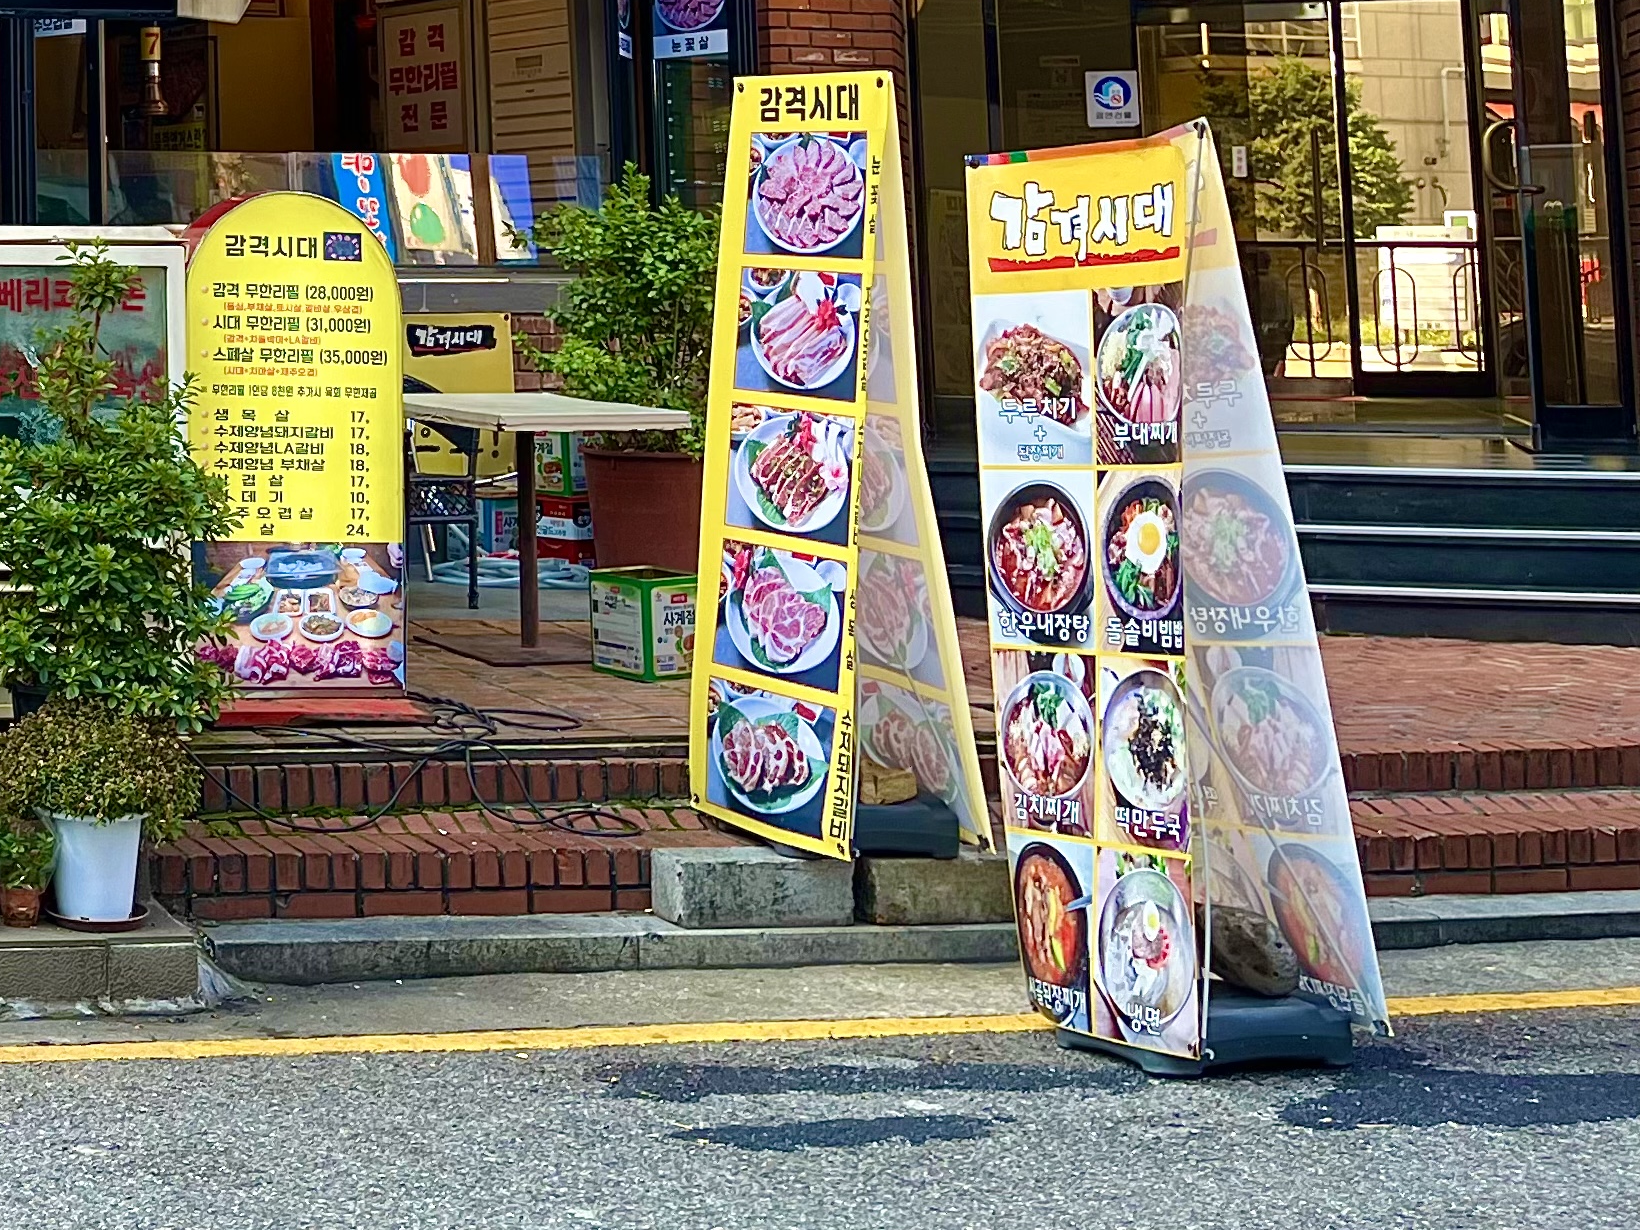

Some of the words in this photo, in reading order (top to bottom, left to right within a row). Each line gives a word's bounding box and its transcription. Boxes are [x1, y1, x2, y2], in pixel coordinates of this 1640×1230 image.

[145, 32, 160, 55] 7
[388, 60, 458, 96] 무한리필
[759, 82, 860, 123] 감격시대
[989, 180, 1175, 262] 감격시대
[224, 233, 318, 260] 감격시대
[212, 282, 240, 299] 감격
[245, 283, 300, 300] 무한리필
[305, 285, 374, 302] (28,000원)
[212, 315, 241, 331] 시대
[246, 316, 300, 332] 무한리필
[306, 317, 371, 334] (31,000원)
[259, 347, 314, 364] 무한리필
[319, 349, 388, 366] (35,000원)
[999, 396, 1078, 424] 두루치기
[1113, 420, 1179, 449] 부대찌개
[997, 609, 1091, 644] 한우내장탕
[1013, 792, 1081, 826] 김치찌개
[1114, 805, 1182, 843] 떡만두국
[1126, 1001, 1161, 1037] 냉면
